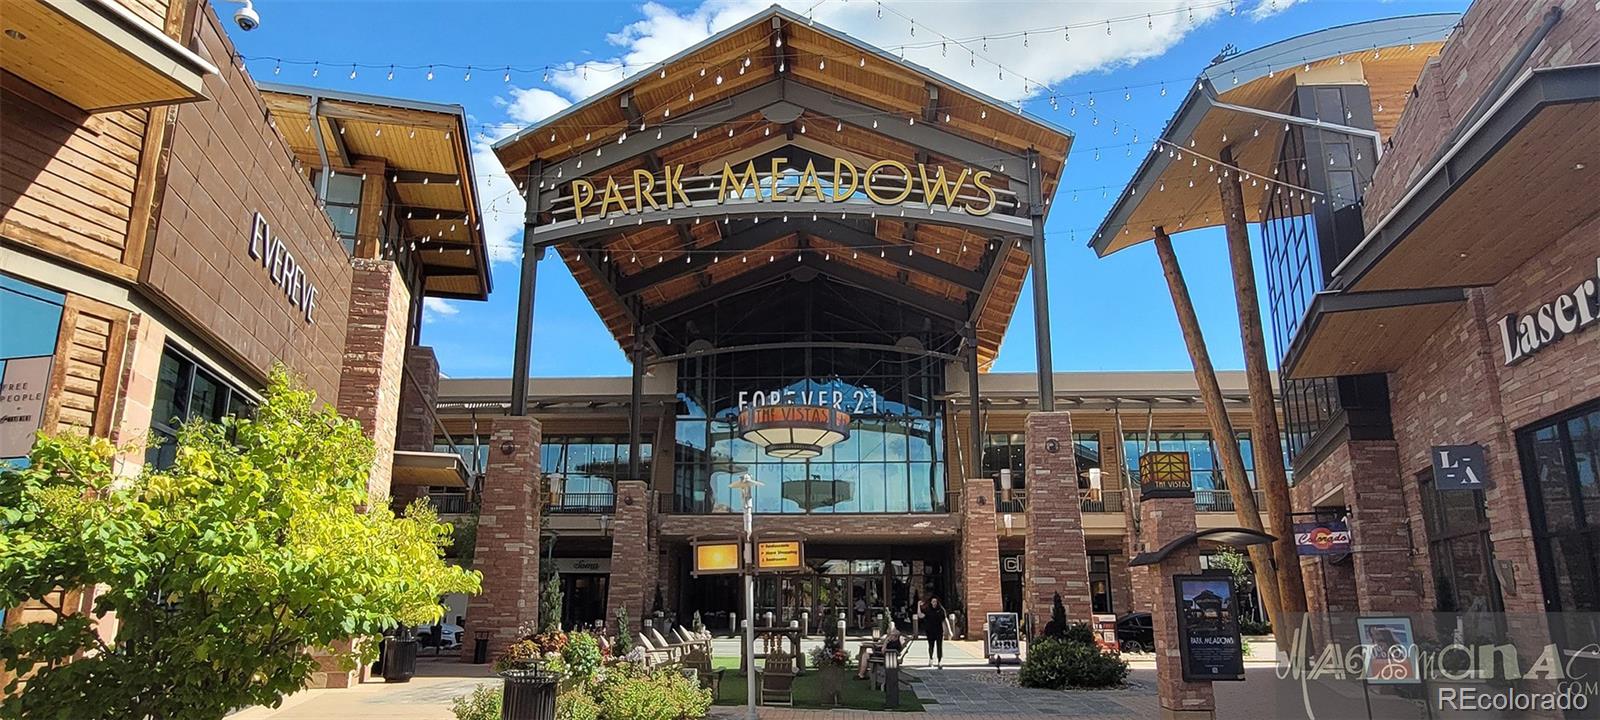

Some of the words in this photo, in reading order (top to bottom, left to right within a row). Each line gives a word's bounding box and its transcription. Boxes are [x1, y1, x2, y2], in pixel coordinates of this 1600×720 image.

[572, 164, 692, 223] PARK
[718, 157, 996, 216] MEADOWS
[250, 211, 319, 324] EVEREVE
[1498, 257, 1600, 366] Laser
[2, 382, 28, 392] FREE
[0, 393, 41, 402] PEOPLE
[853, 390, 877, 414] 21
[781, 408, 828, 420] VISTAS
[1167, 480, 1191, 488] VISTAS
[1299, 533, 1347, 545] Coorado
[1190, 636, 1203, 645] PARK
[1204, 636, 1235, 645] MEADOWS
